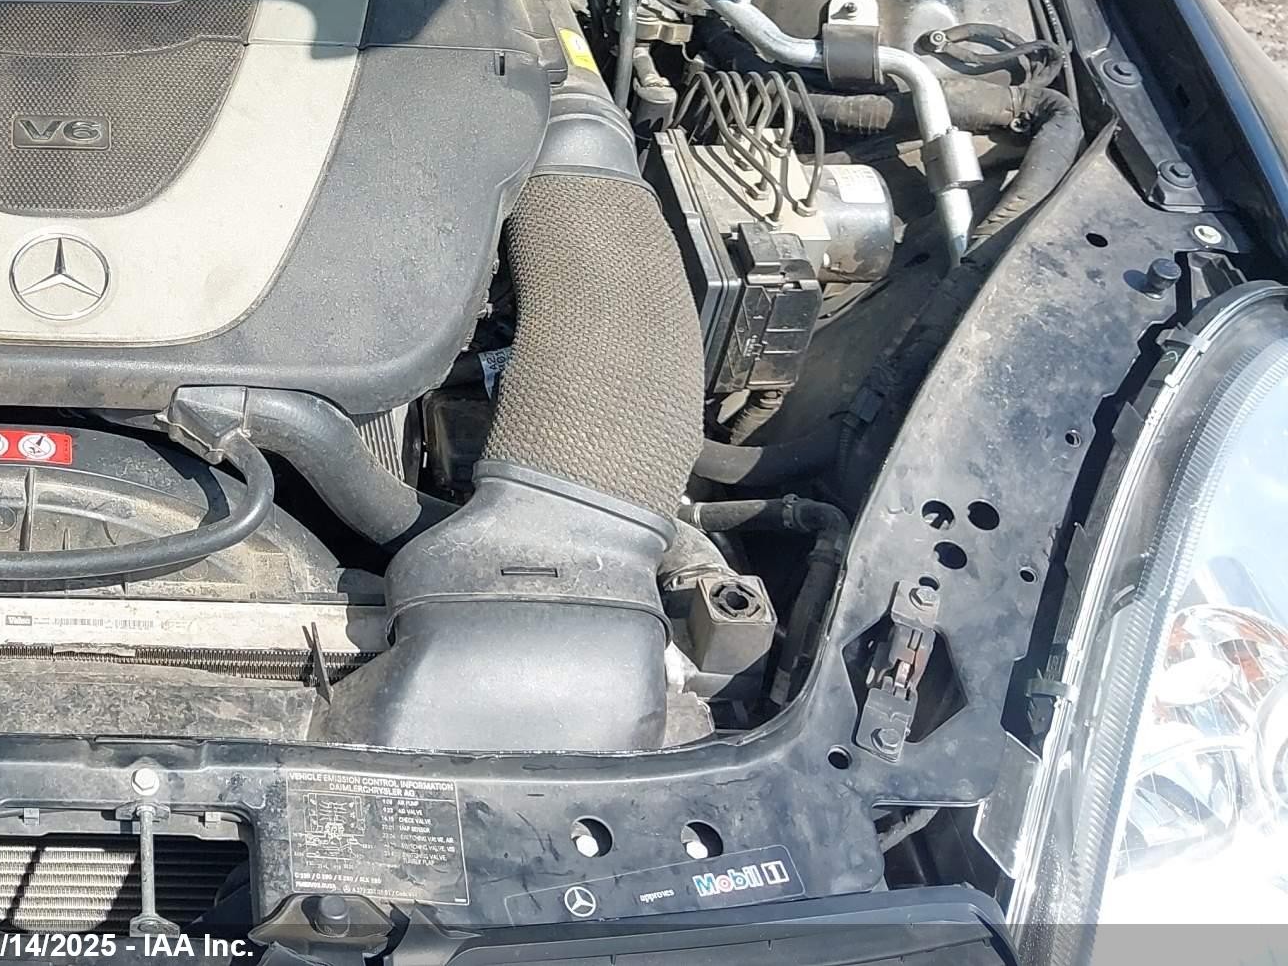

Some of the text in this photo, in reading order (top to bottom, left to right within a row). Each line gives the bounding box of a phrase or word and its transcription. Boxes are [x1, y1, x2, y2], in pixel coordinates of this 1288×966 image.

[19, 120, 102, 144] V6
[289, 773, 454, 791] VEHICLE EMISSION CONTROL INFORMATION
[329, 784, 402, 796] DAIMLERCHRYSLER
[692, 864, 764, 897] Mobil
[764, 862, 787, 883] 1
